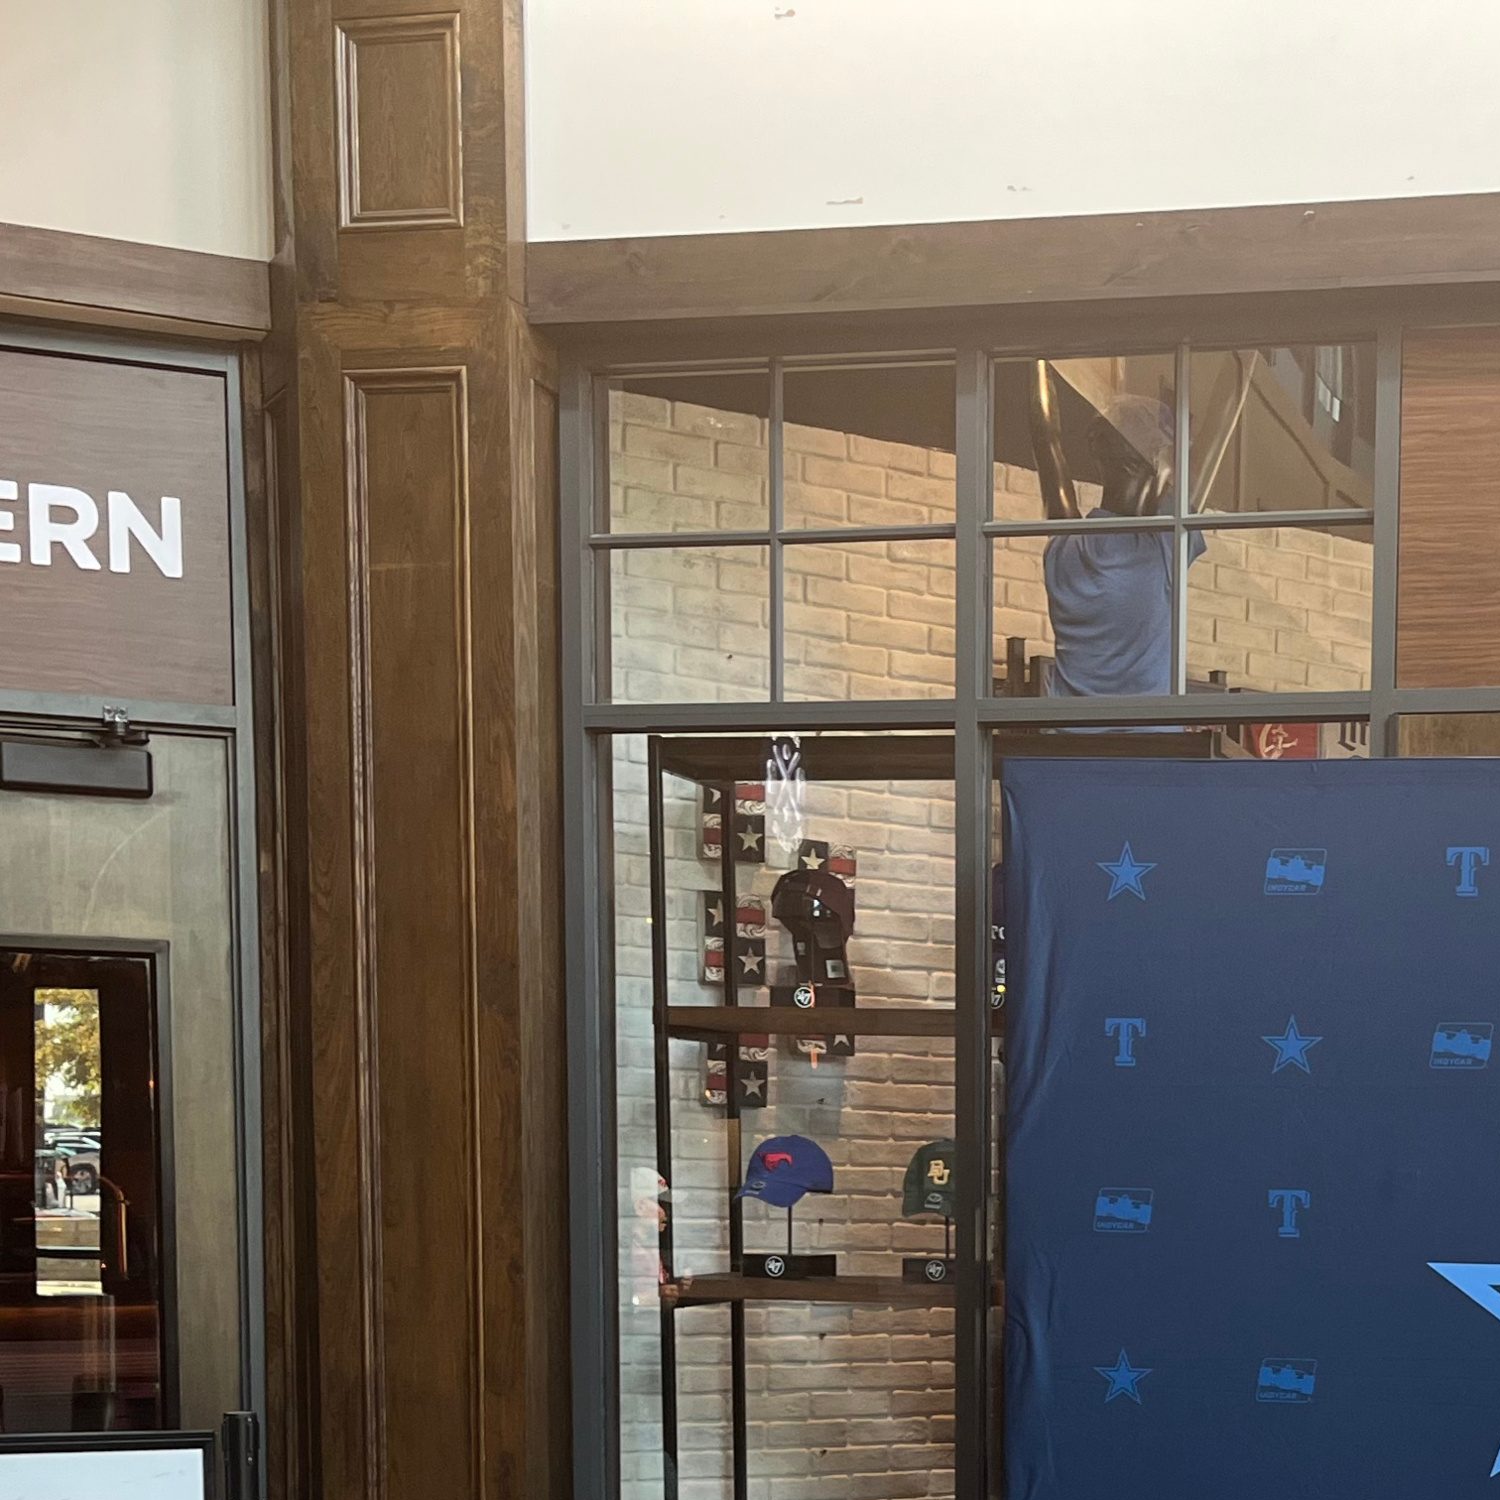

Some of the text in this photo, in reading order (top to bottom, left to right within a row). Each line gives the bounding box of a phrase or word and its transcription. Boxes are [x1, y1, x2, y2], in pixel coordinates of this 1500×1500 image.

[1446, 846, 1490, 897] T
[1105, 1017, 1147, 1066] T
[1268, 1189, 1311, 1238] T
